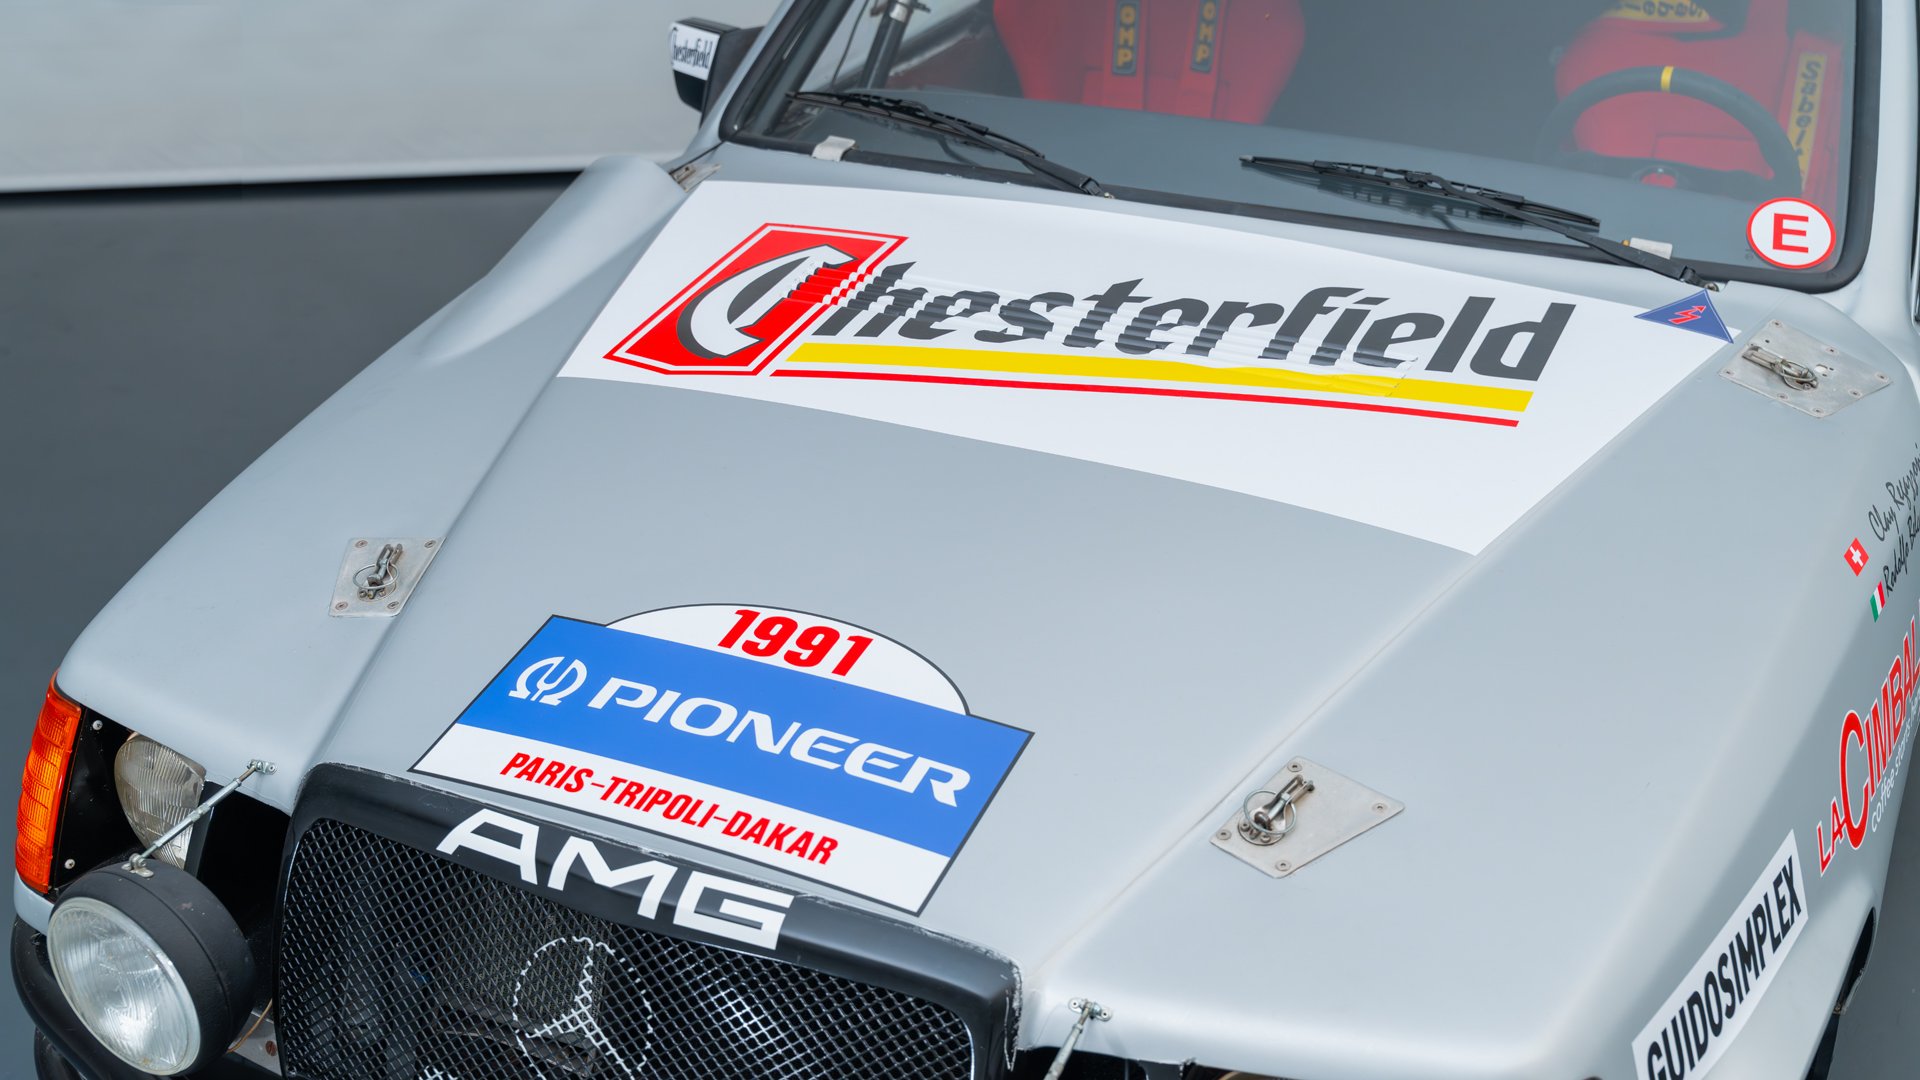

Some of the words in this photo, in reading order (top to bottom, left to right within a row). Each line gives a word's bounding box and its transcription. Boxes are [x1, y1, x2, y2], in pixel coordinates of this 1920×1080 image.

[1117, 5, 1136, 67] OMP
[1196, 1, 1215, 63] OMP
[1773, 213, 1809, 253] E
[677, 243, 1576, 382] Chesterfield
[717, 609, 873, 676] 1991
[588, 676, 971, 808] PIONEER
[1872, 768, 1895, 833] coffee
[436, 808, 795, 950] AMG
[1647, 855, 1801, 1080] GUIDOSIMPLEX
